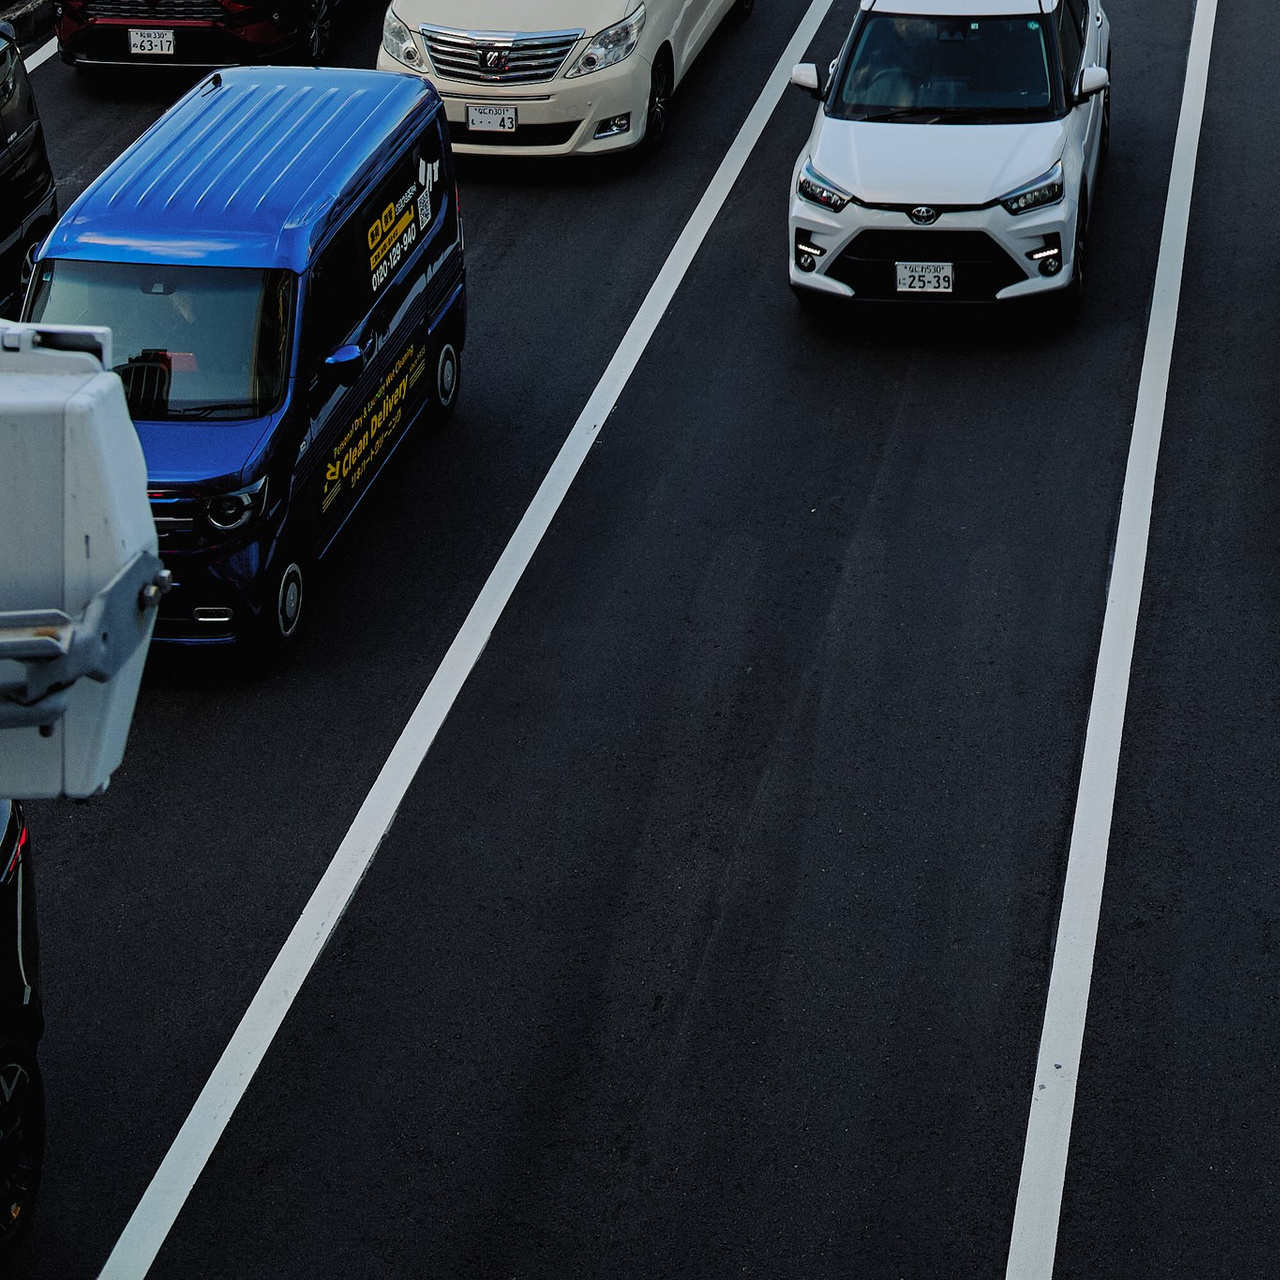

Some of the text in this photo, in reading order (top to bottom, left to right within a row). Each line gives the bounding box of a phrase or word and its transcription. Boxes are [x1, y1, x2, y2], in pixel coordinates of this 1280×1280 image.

[138, 39, 173, 52] 63-17
[477, 106, 506, 115] なにわ301
[907, 265, 942, 274] なにわ530
[907, 274, 951, 290] 25-39
[333, 425, 355, 460] Personal
[354, 416, 363, 431] Dry
[367, 385, 387, 413] Laundry
[385, 370, 396, 388] Wet
[394, 343, 415, 376] Cleaning
[341, 373, 409, 479] Clean Delivery
